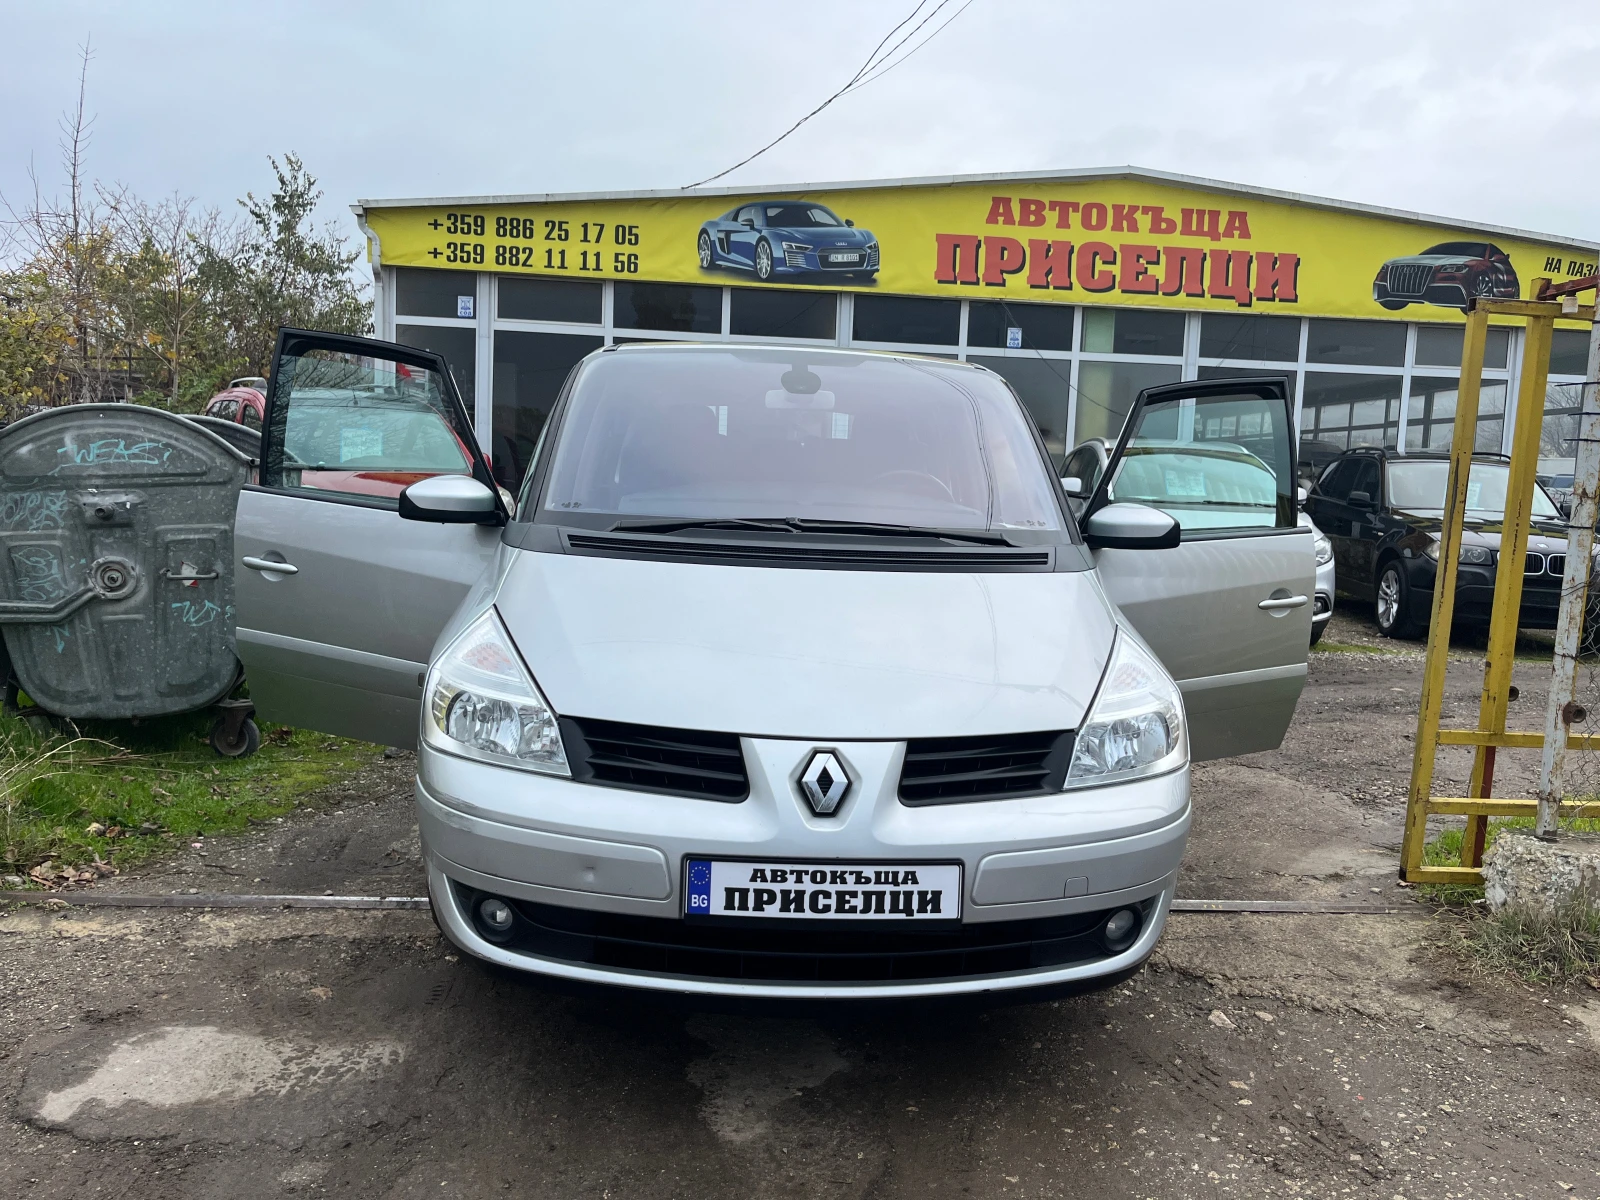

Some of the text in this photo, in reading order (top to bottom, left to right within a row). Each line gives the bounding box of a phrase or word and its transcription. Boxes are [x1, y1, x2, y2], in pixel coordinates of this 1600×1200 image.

[427, 212, 640, 246] +359 886 25 17 05
[985, 196, 1251, 242] АВТОКЪЩА
[427, 241, 639, 274] +359 882 11 11 56
[934, 233, 1301, 307] ПРИСЕЛЦИ
[1543, 256, 1562, 274] НА
[749, 868, 920, 887] АВТОКЪЩА
[690, 894, 709, 909] BG
[723, 886, 943, 917] ПРИСЕЛЦИ
